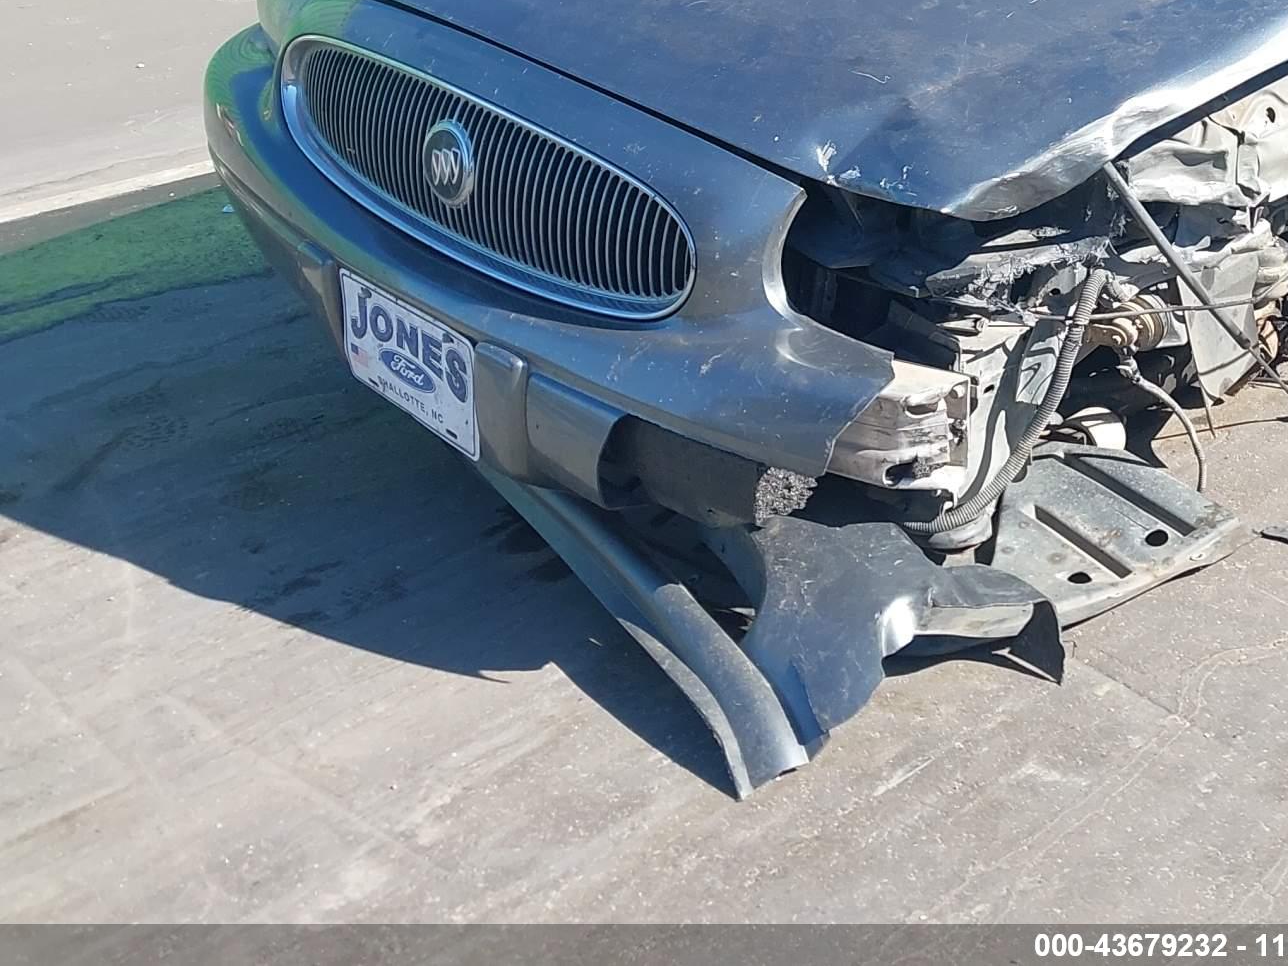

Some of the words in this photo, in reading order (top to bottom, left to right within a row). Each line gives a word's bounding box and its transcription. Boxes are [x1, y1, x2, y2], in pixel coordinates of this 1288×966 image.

[350, 287, 468, 404] JONES
[390, 353, 425, 387] Ford
[431, 409, 444, 425] NC
